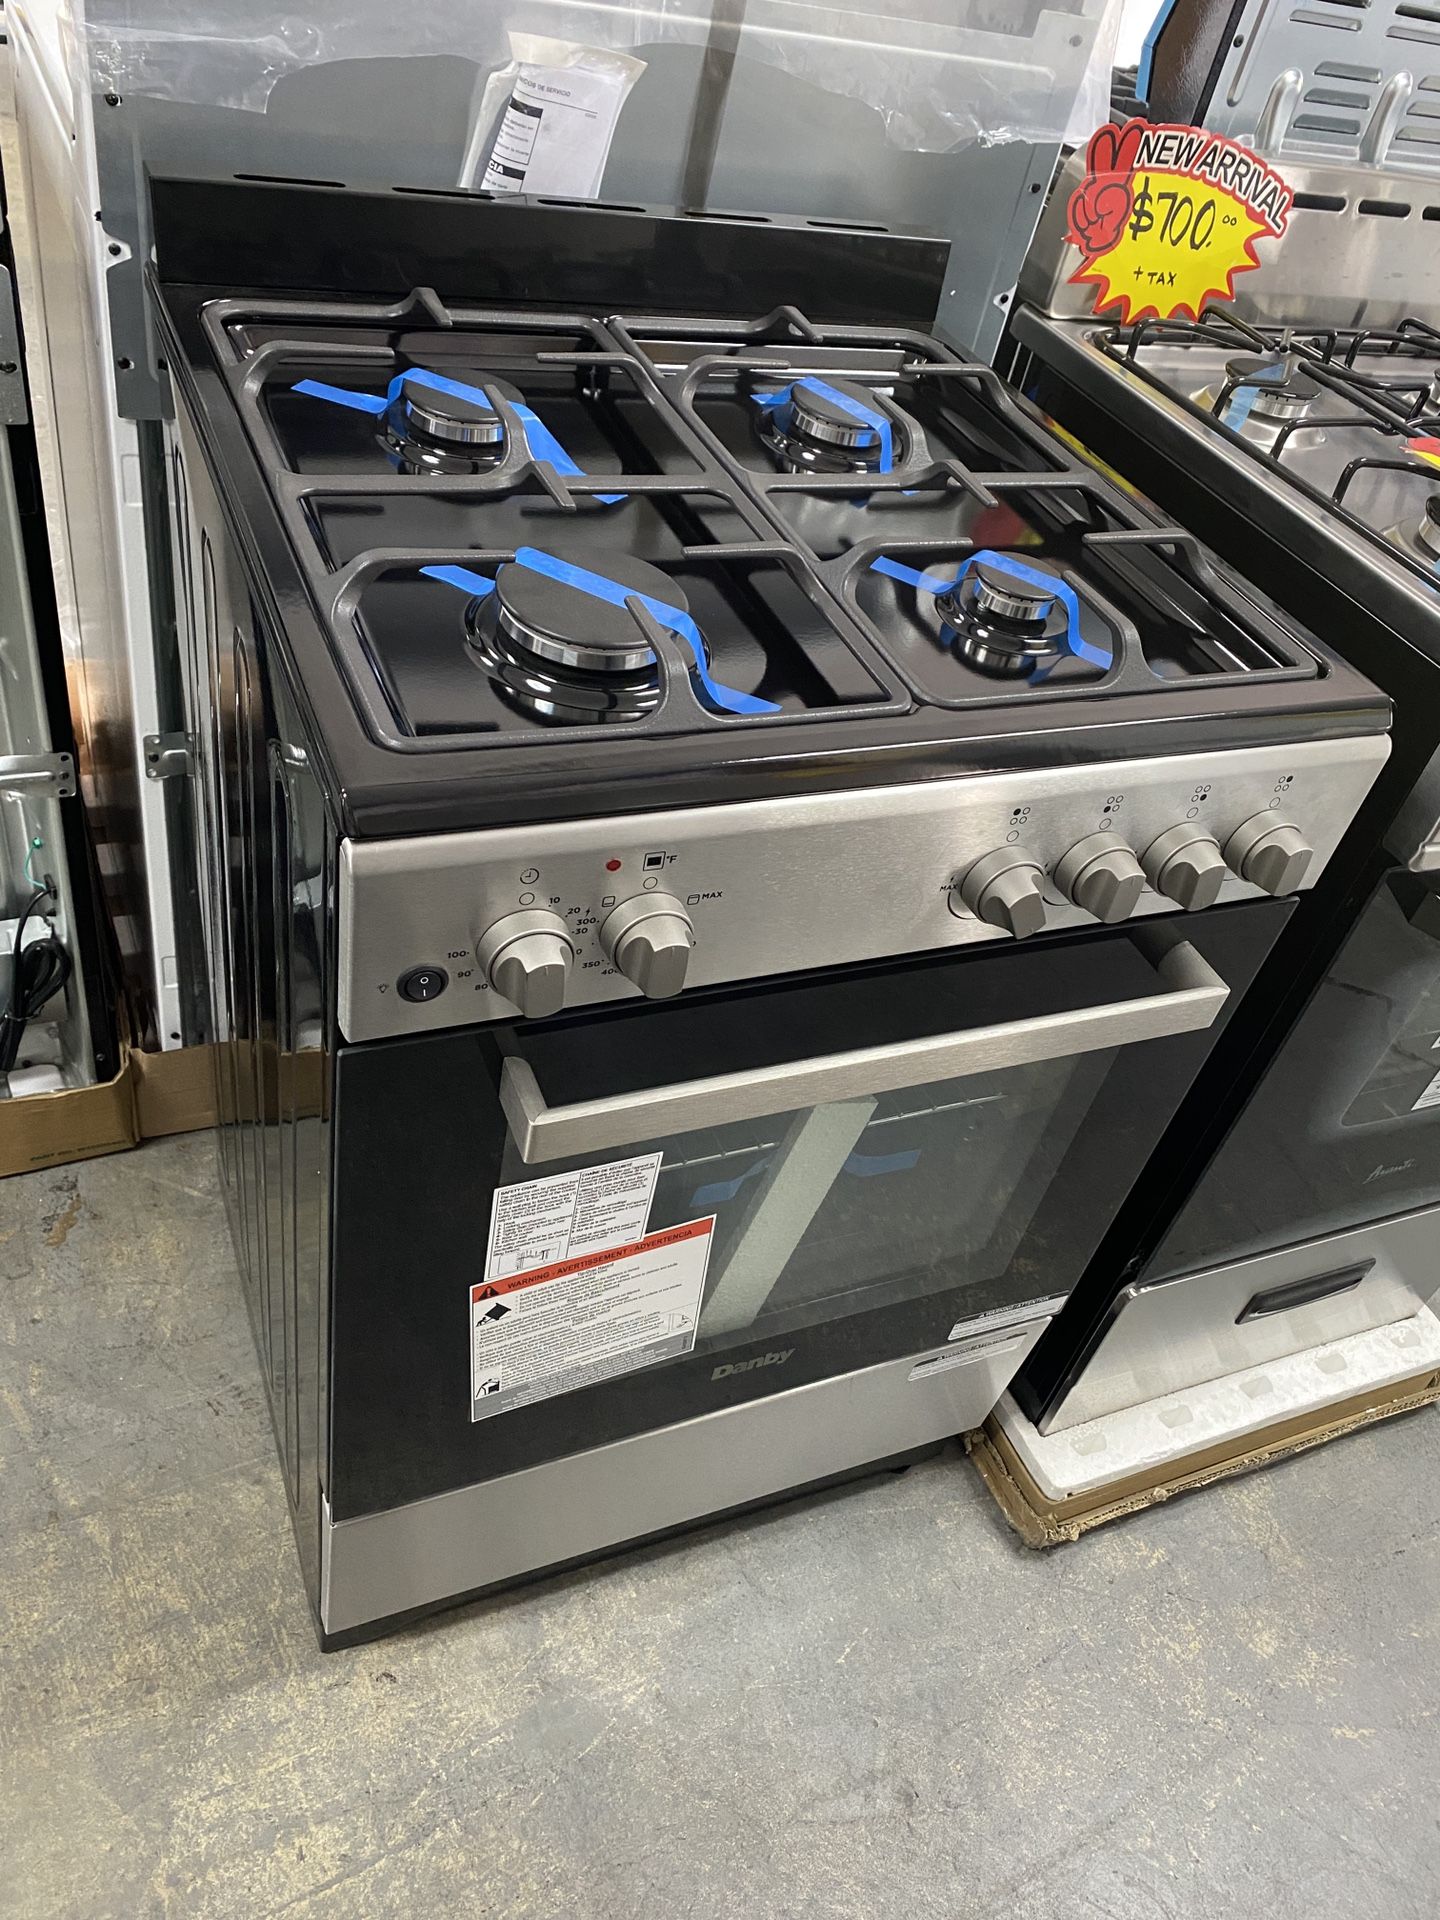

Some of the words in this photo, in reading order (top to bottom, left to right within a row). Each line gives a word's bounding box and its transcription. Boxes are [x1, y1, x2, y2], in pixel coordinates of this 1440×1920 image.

[1135, 133, 1204, 169] NEW
[1195, 144, 1289, 230] ARRIVAL
[1147, 271, 1177, 288] TAX
[702, 890, 723, 900] MAX
[549, 896, 561, 905] 10
[567, 907, 581, 915] 20
[447, 951, 468, 959] 100
[581, 960, 602, 969] 350
[457, 970, 471, 979] 90
[474, 983, 489, 991] 80
[507, 1271, 549, 1289] WARNING
[556, 1247, 627, 1274] AVERTISSEMENT
[633, 1228, 692, 1251] ADVERTENCIA
[711, 1347, 797, 1381] Danby
